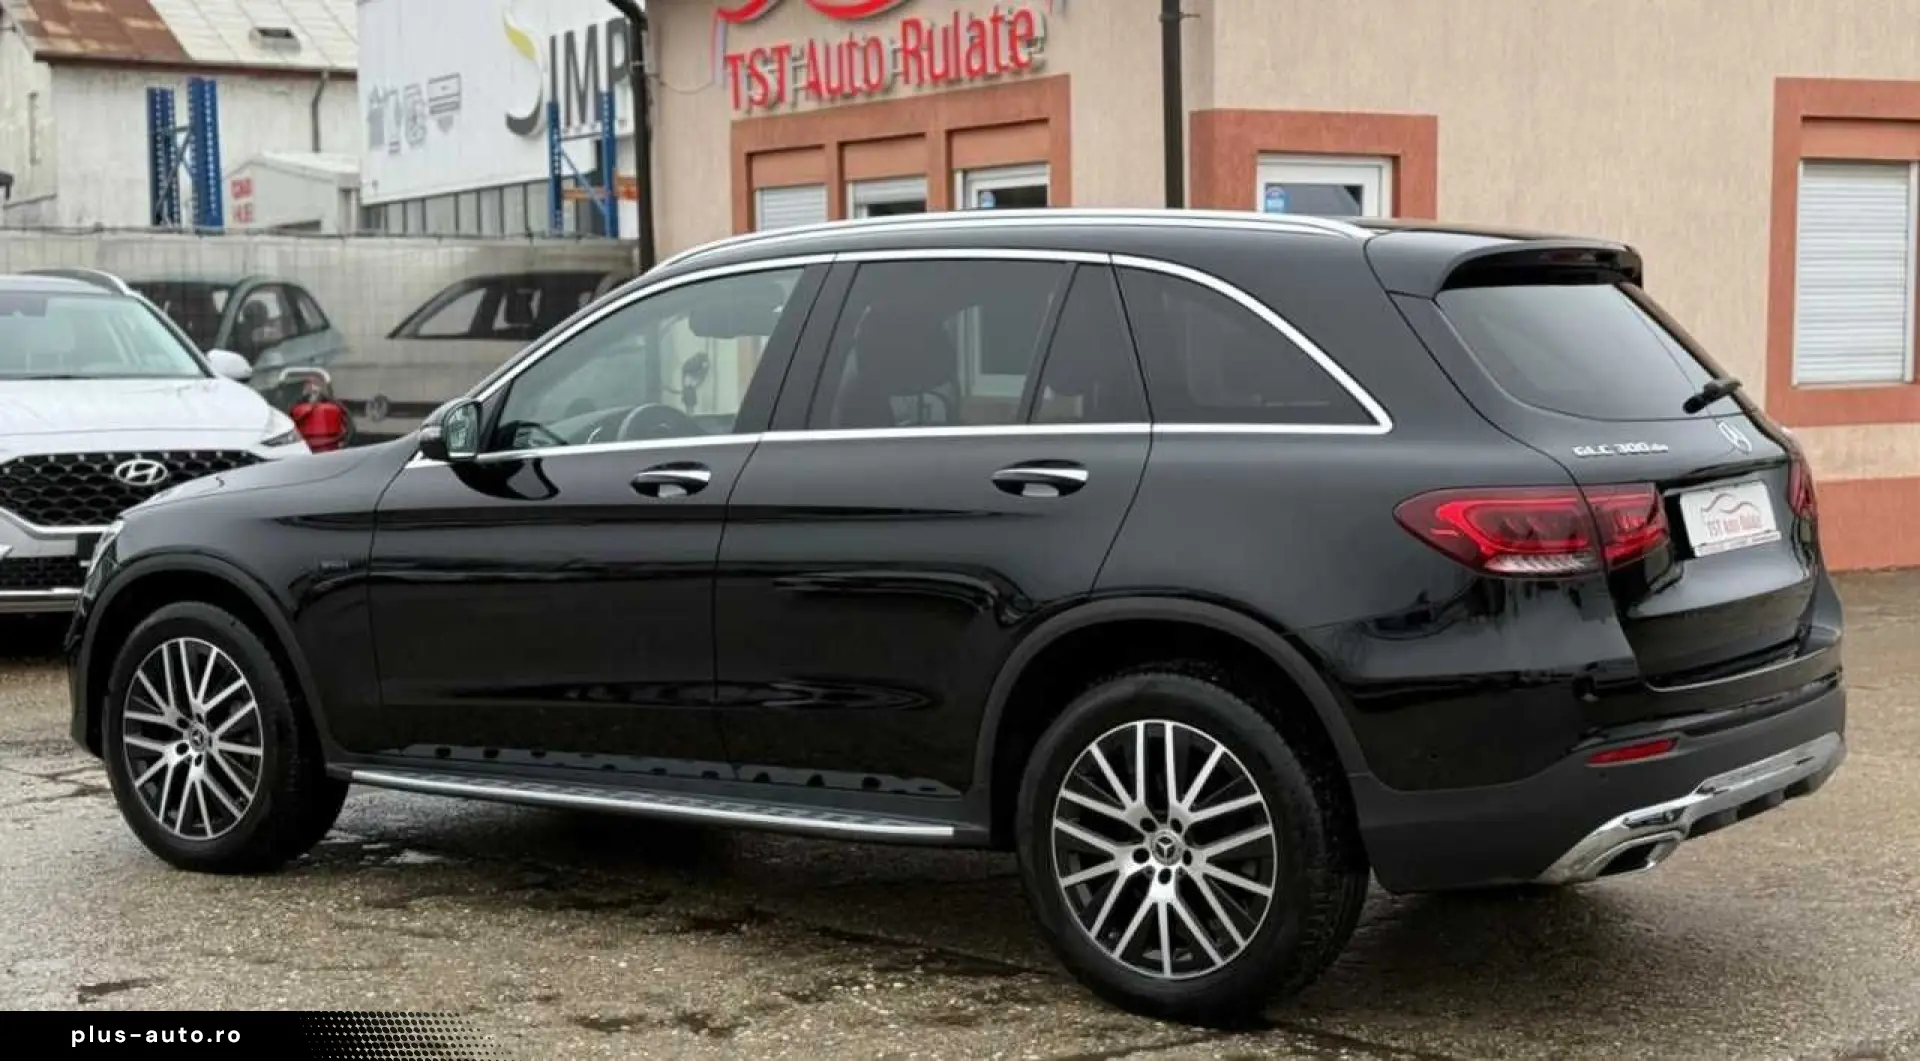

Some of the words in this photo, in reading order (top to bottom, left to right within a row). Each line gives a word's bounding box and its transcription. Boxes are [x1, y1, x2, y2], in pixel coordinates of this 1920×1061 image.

[725, 43, 791, 110] TST
[805, 36, 885, 99] Auto
[901, 8, 1036, 86] Rulate
